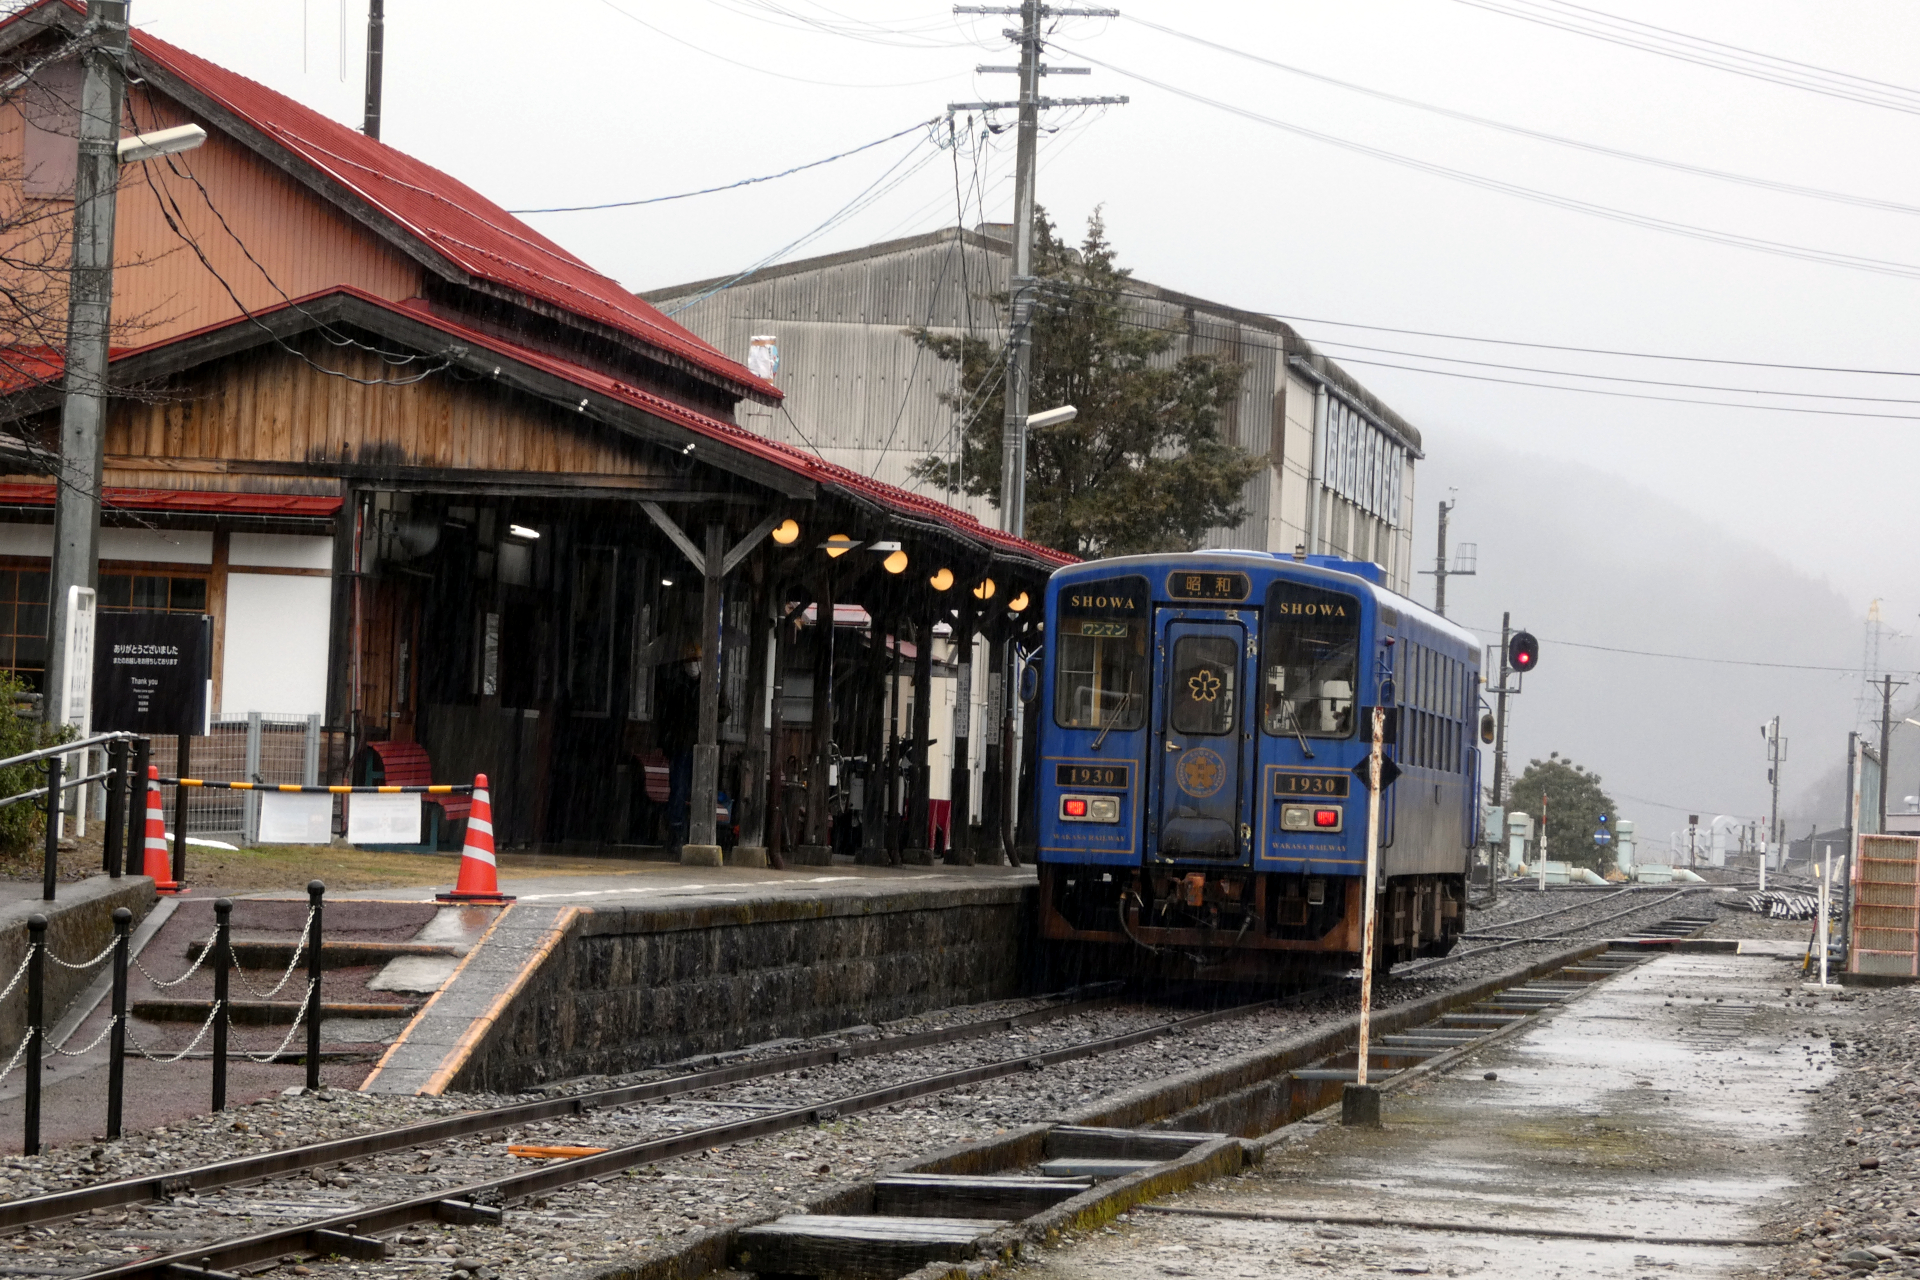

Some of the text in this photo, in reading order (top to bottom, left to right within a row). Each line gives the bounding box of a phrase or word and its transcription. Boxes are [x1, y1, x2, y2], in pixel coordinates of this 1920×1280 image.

[1186, 576, 1231, 592] 昭和
[1071, 595, 1135, 609] SHOWA
[1279, 602, 1346, 617] SHOWA
[1083, 623, 1126, 636] ワンマン
[113, 644, 178, 655] ありがとうございました
[131, 677, 158, 687] Thank you
[1070, 768, 1115, 784] 1930
[1288, 777, 1336, 793] 1930
[1053, 833, 1086, 841] WAKASA
[1272, 842, 1347, 852] WAKASA RAILWAY
